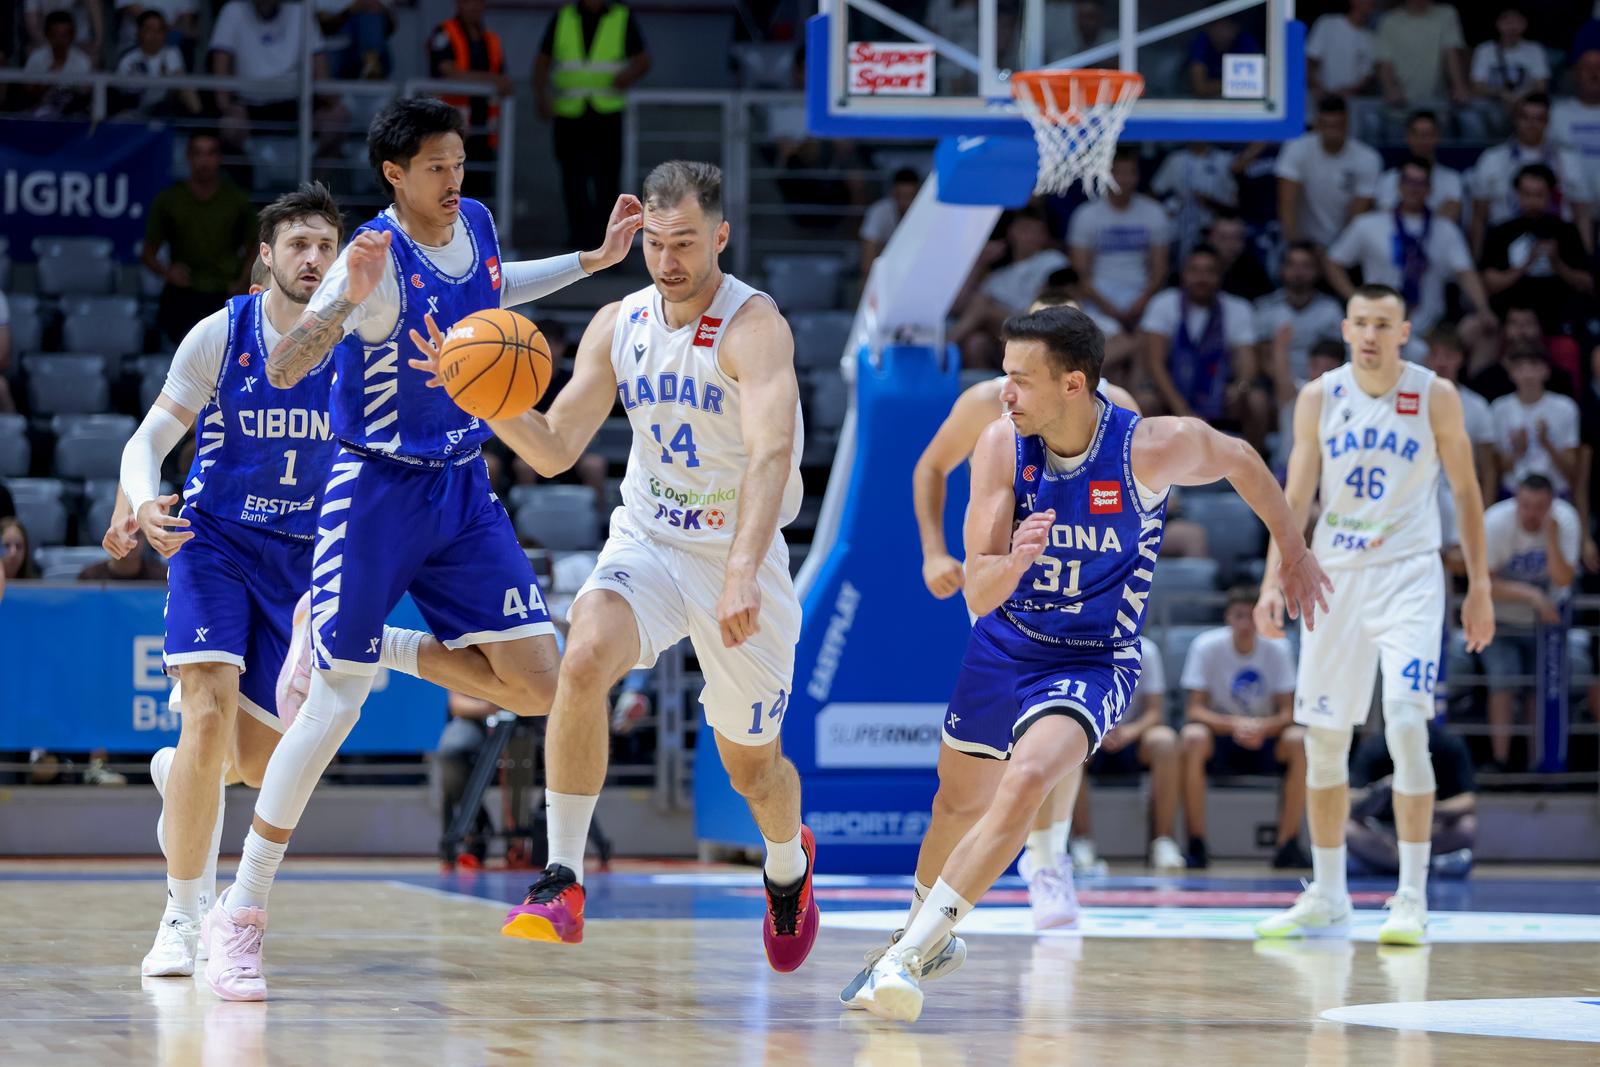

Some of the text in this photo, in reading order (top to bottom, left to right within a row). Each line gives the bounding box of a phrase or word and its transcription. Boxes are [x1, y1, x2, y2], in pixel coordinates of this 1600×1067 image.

[850, 42, 936, 68] Super
[856, 68, 926, 96] Sport
[4, 169, 143, 219] IGRU.
[617, 371, 725, 415] ZADAR
[238, 408, 335, 441] CIBON
[651, 423, 700, 468] 14
[1326, 427, 1420, 463] ZADAR
[279, 449, 297, 486] 1
[1345, 466, 1387, 500] 46
[1091, 489, 1119, 498] Super
[1093, 497, 1118, 506] Sport
[240, 510, 269, 523] Bank
[1045, 524, 1122, 553] ONA
[1032, 555, 1082, 597] 31
[503, 583, 548, 620] 44
[1047, 679, 1087, 703] 31
[747, 688, 786, 734] 14
